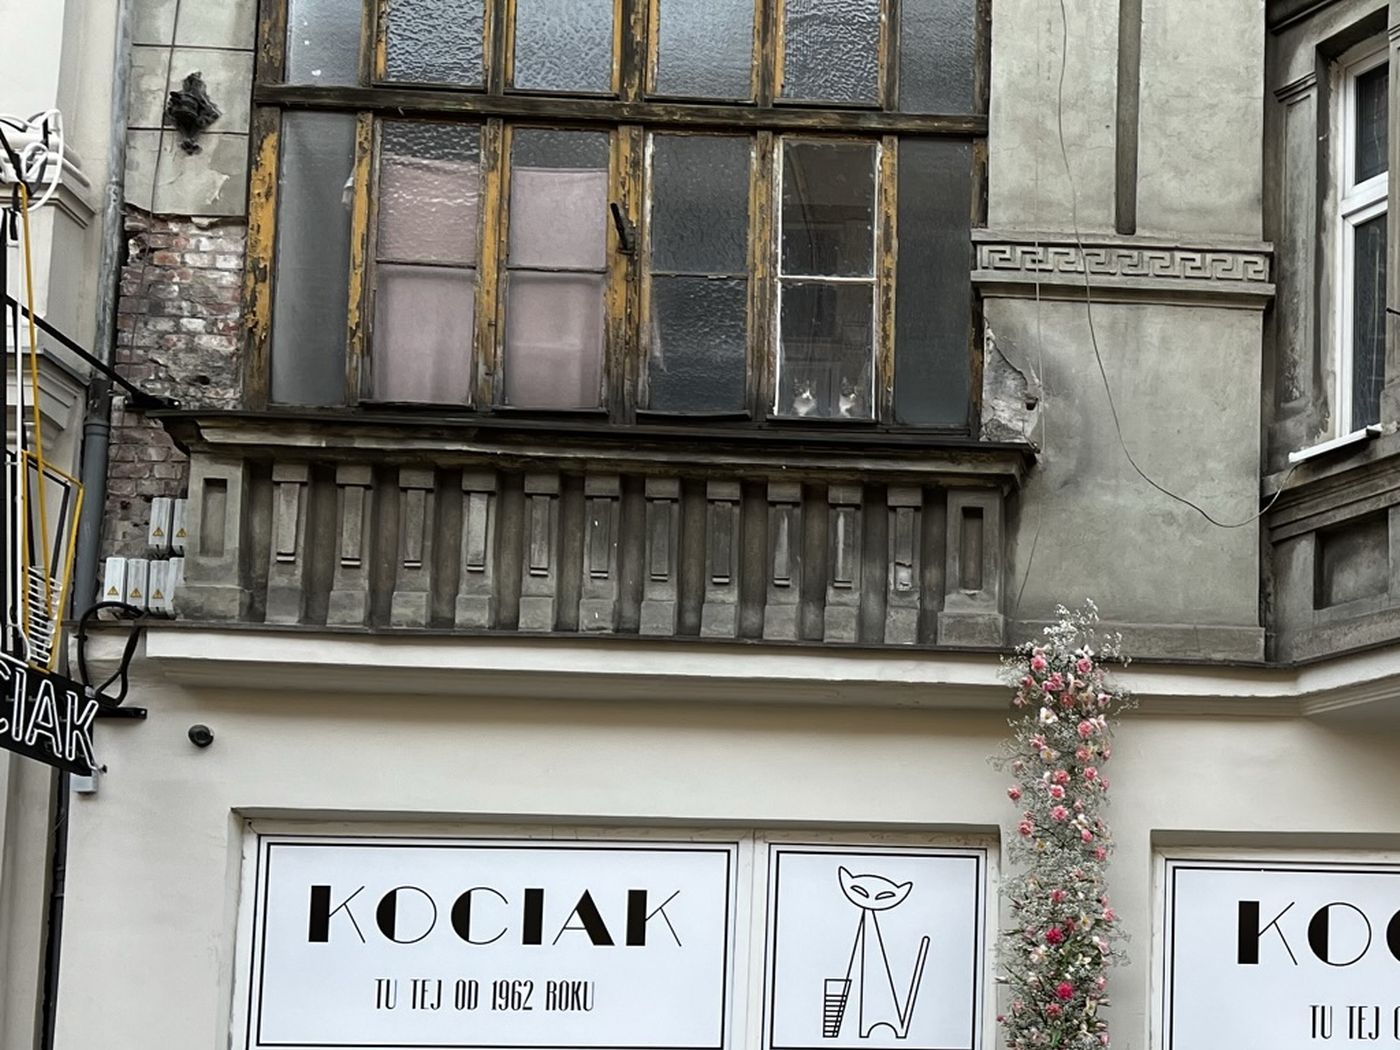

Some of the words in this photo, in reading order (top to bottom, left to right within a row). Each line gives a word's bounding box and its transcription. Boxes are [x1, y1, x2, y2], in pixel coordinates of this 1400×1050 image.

[308, 884, 682, 947] KOCIAK
[375, 978, 398, 1010] TU
[411, 978, 442, 1011] TEJ
[455, 979, 479, 1011] OD
[491, 980, 534, 1012] 1962
[546, 980, 595, 1012] ROKU
[1310, 1005, 1333, 1040] TU
[1346, 1005, 1380, 1041] TEJ
